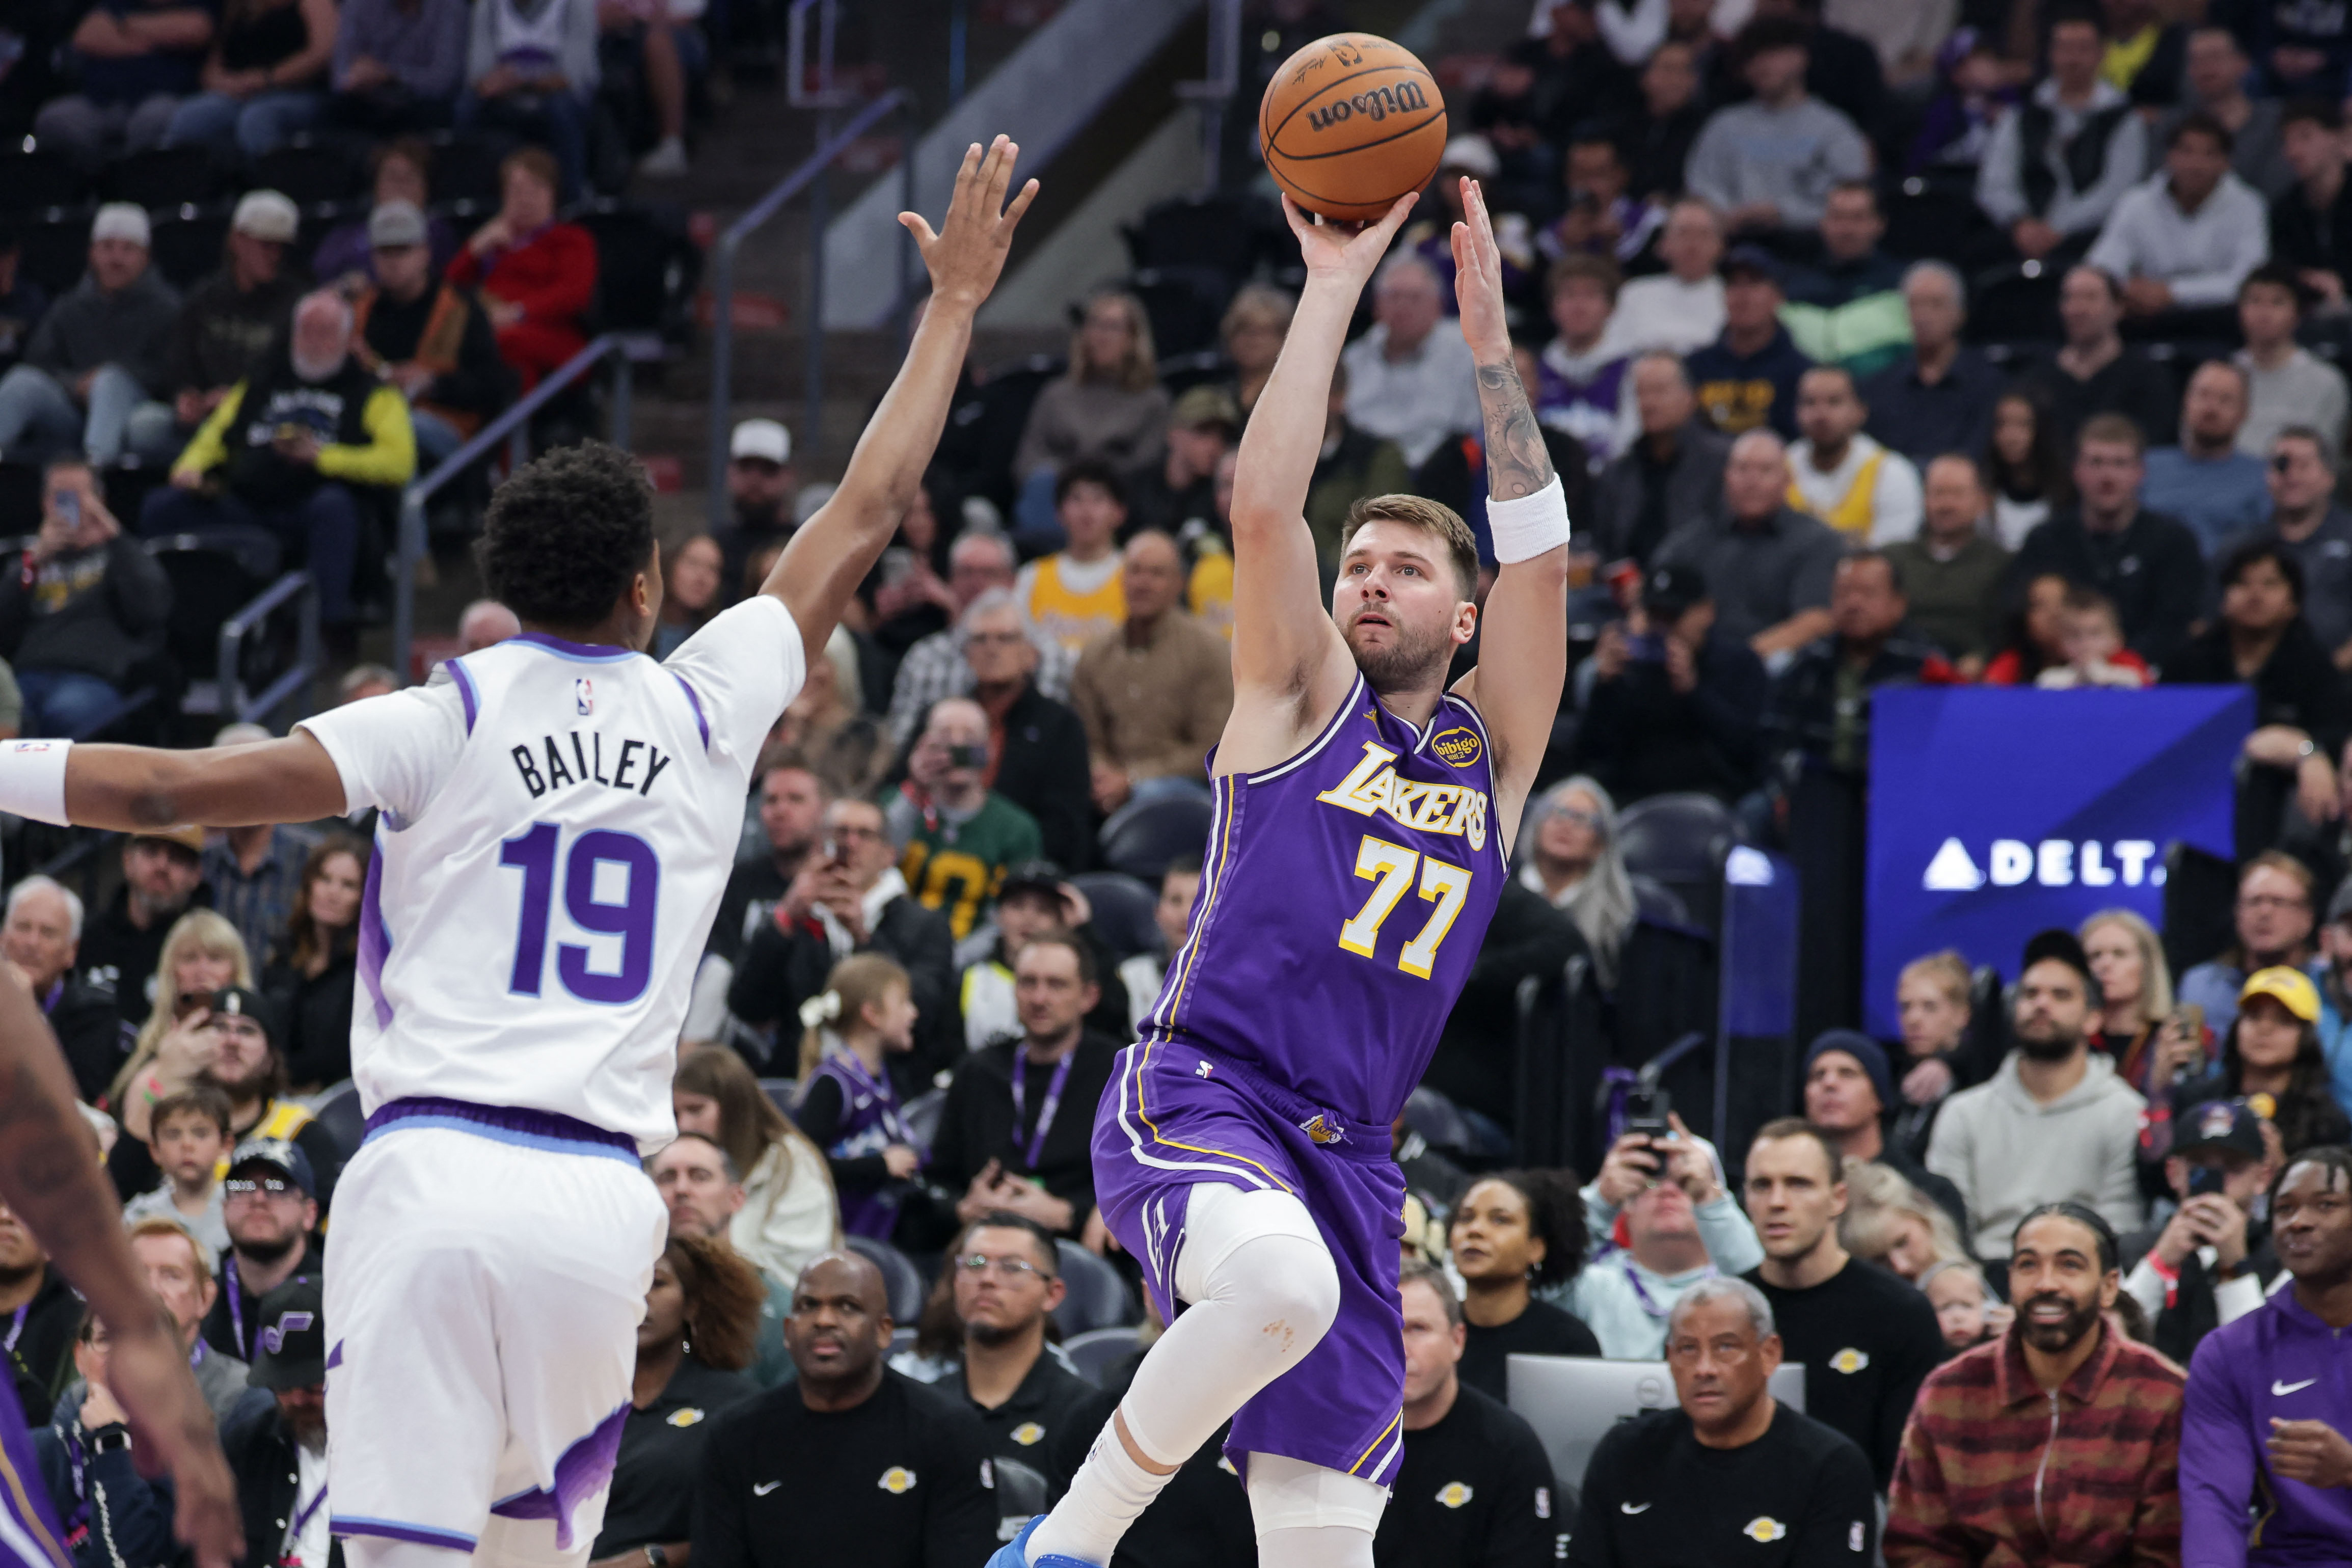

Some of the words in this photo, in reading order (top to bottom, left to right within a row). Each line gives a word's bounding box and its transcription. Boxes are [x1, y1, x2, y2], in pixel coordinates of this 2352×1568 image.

[1306, 79, 1430, 132] Wilson
[511, 731, 671, 800] BAILEY
[1435, 738, 1478, 755] bibigo
[1315, 740, 1488, 851] LAKERS
[1989, 838, 2168, 888] DELT
[497, 821, 661, 1007] 19
[1338, 833, 1473, 980] 77
